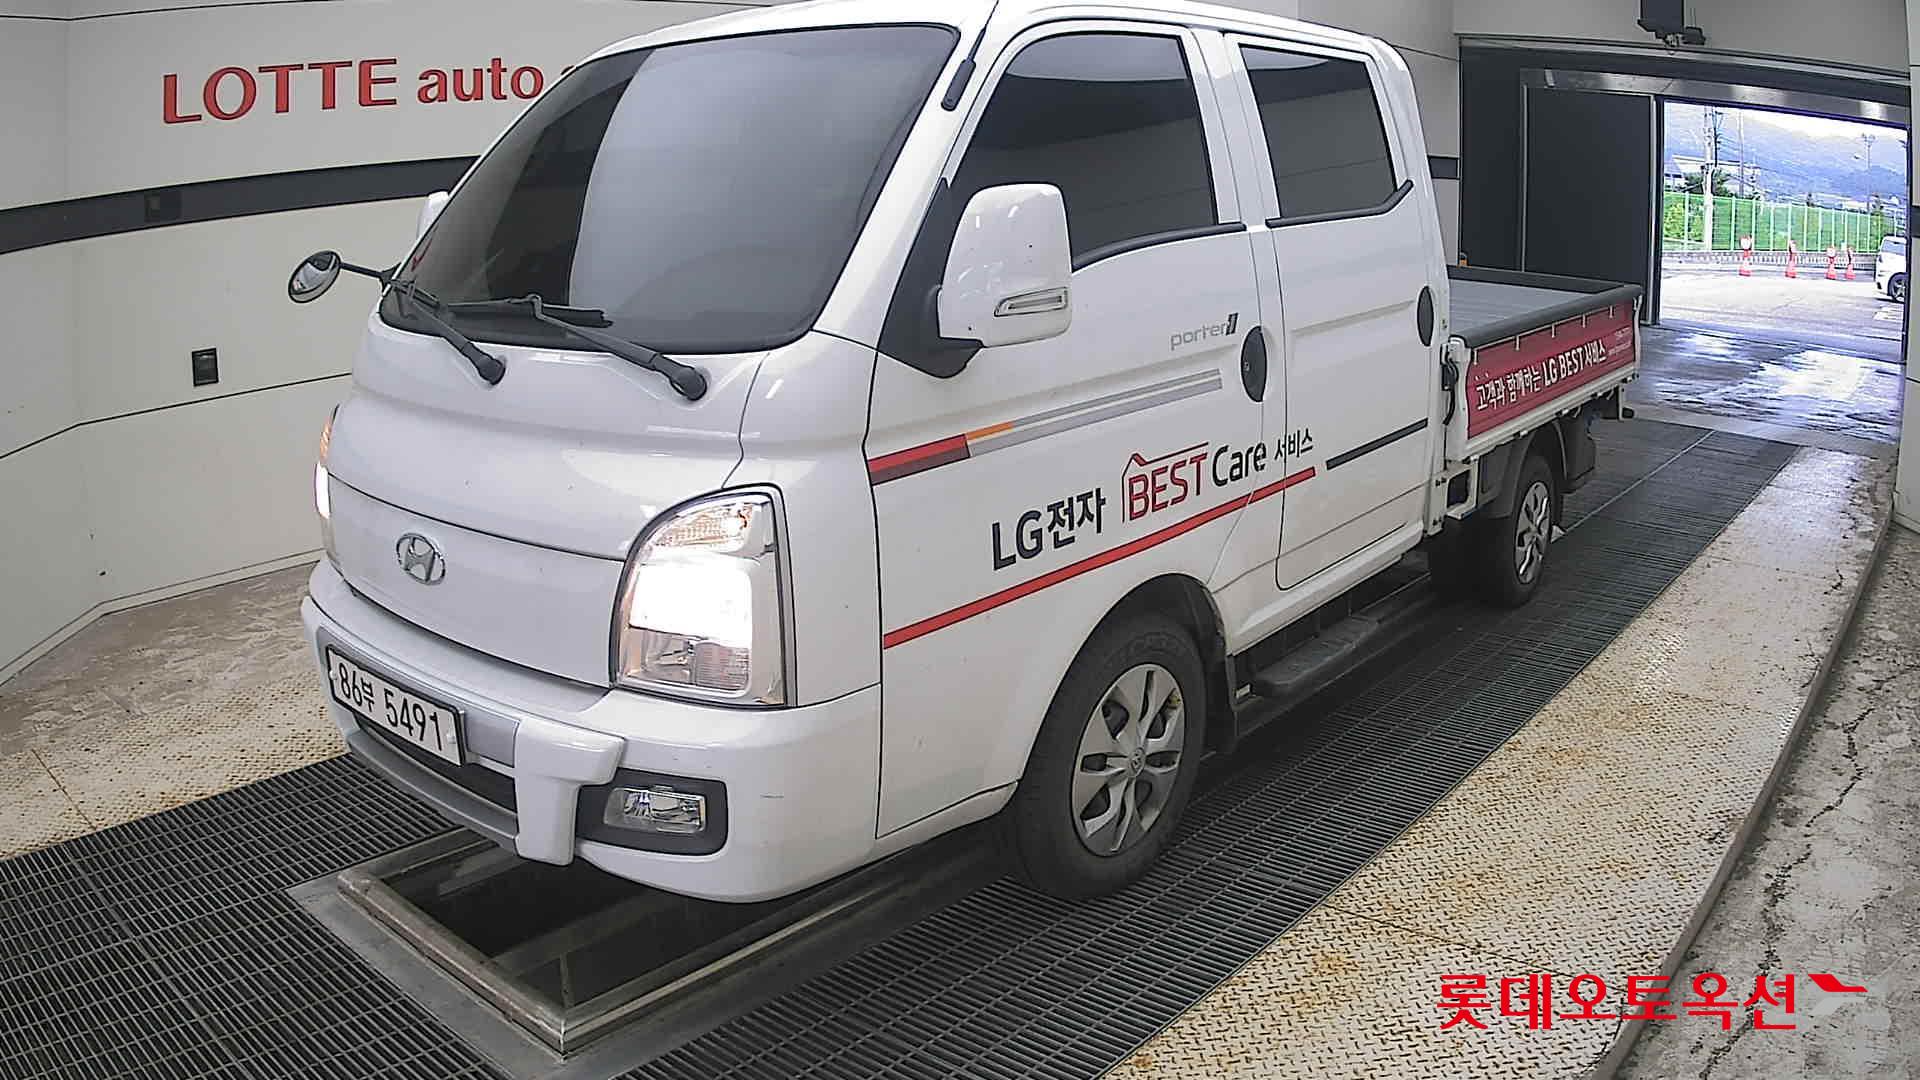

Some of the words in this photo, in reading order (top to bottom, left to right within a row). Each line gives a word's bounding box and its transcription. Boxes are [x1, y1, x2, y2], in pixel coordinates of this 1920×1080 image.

[163, 58, 398, 124] LOTTE
[417, 57, 545, 104] auto
[1476, 377, 1505, 410] 고객과
[1507, 366, 1541, 402] 함께하는
[1542, 357, 1558, 386] LG
[1558, 346, 1584, 379] BEST
[991, 487, 1106, 571] LG전자
[1128, 452, 1208, 521] BEST
[1212, 441, 1267, 487] Care
[1273, 427, 1314, 463] 서비스
[338, 662, 375, 712] 86부
[383, 687, 442, 751] 5491
